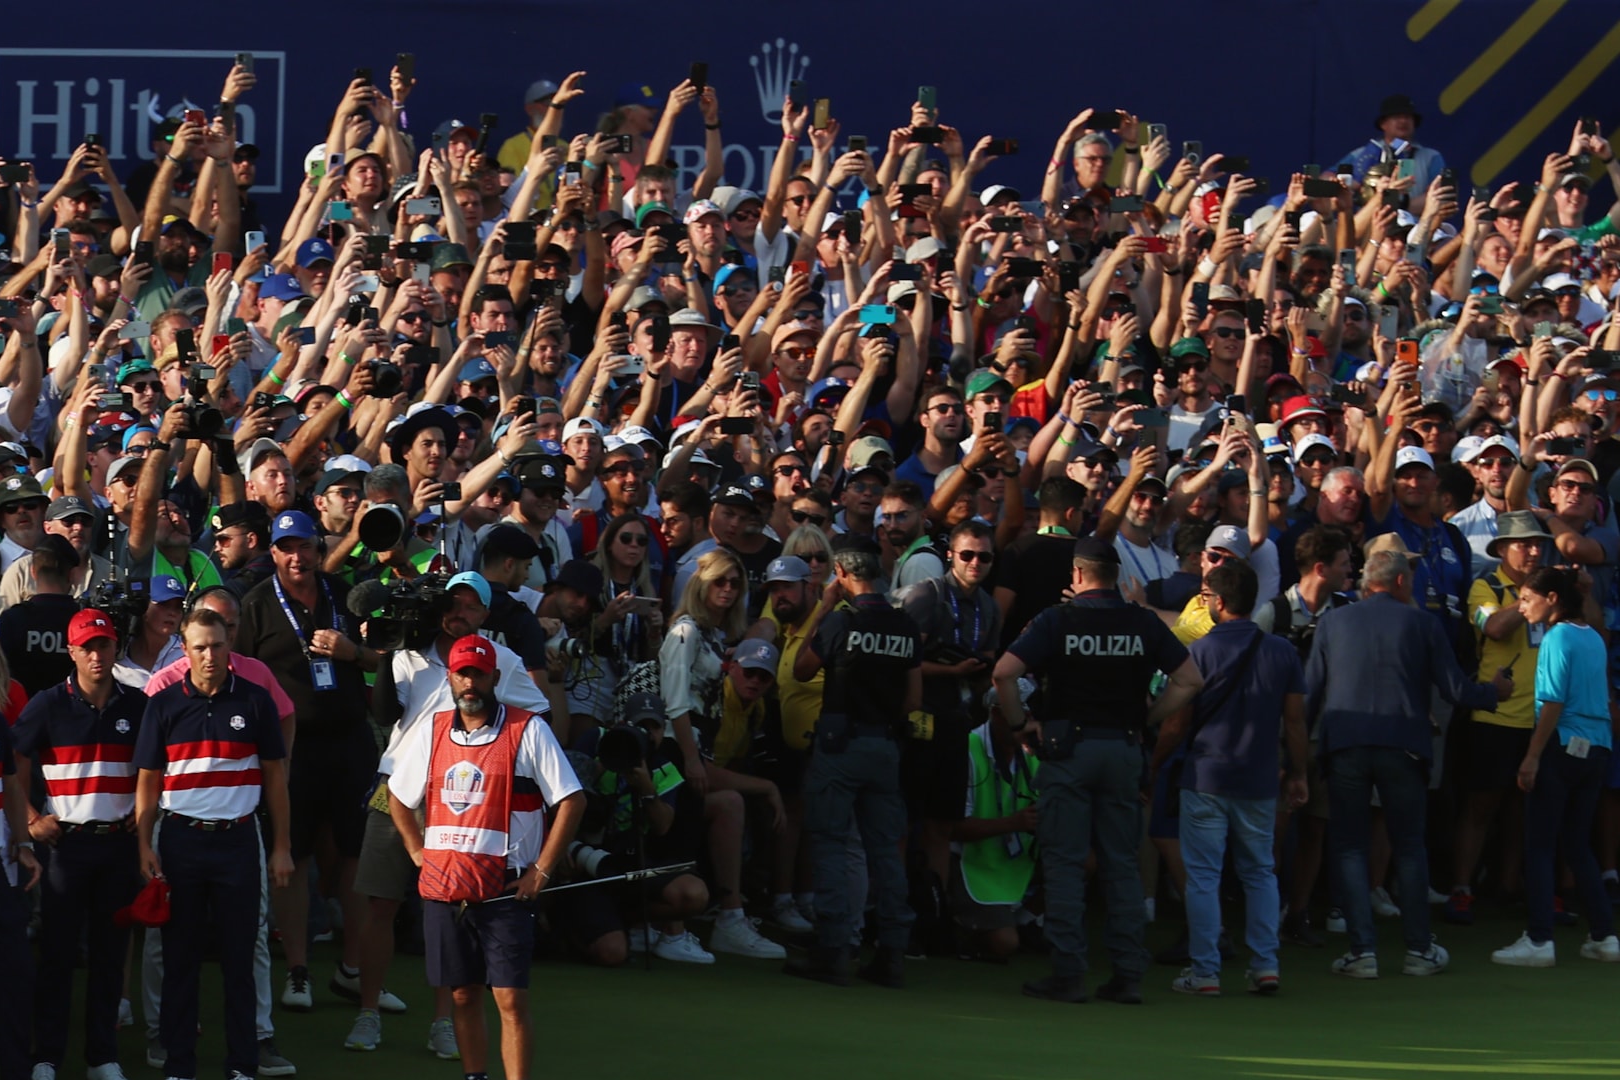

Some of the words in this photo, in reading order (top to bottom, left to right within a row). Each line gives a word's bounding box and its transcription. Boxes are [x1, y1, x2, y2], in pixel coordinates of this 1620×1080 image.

[846, 630, 915, 659] POLIZIA
[1064, 634, 1145, 656] POLIZIA
[438, 831, 477, 846] SPIETH
